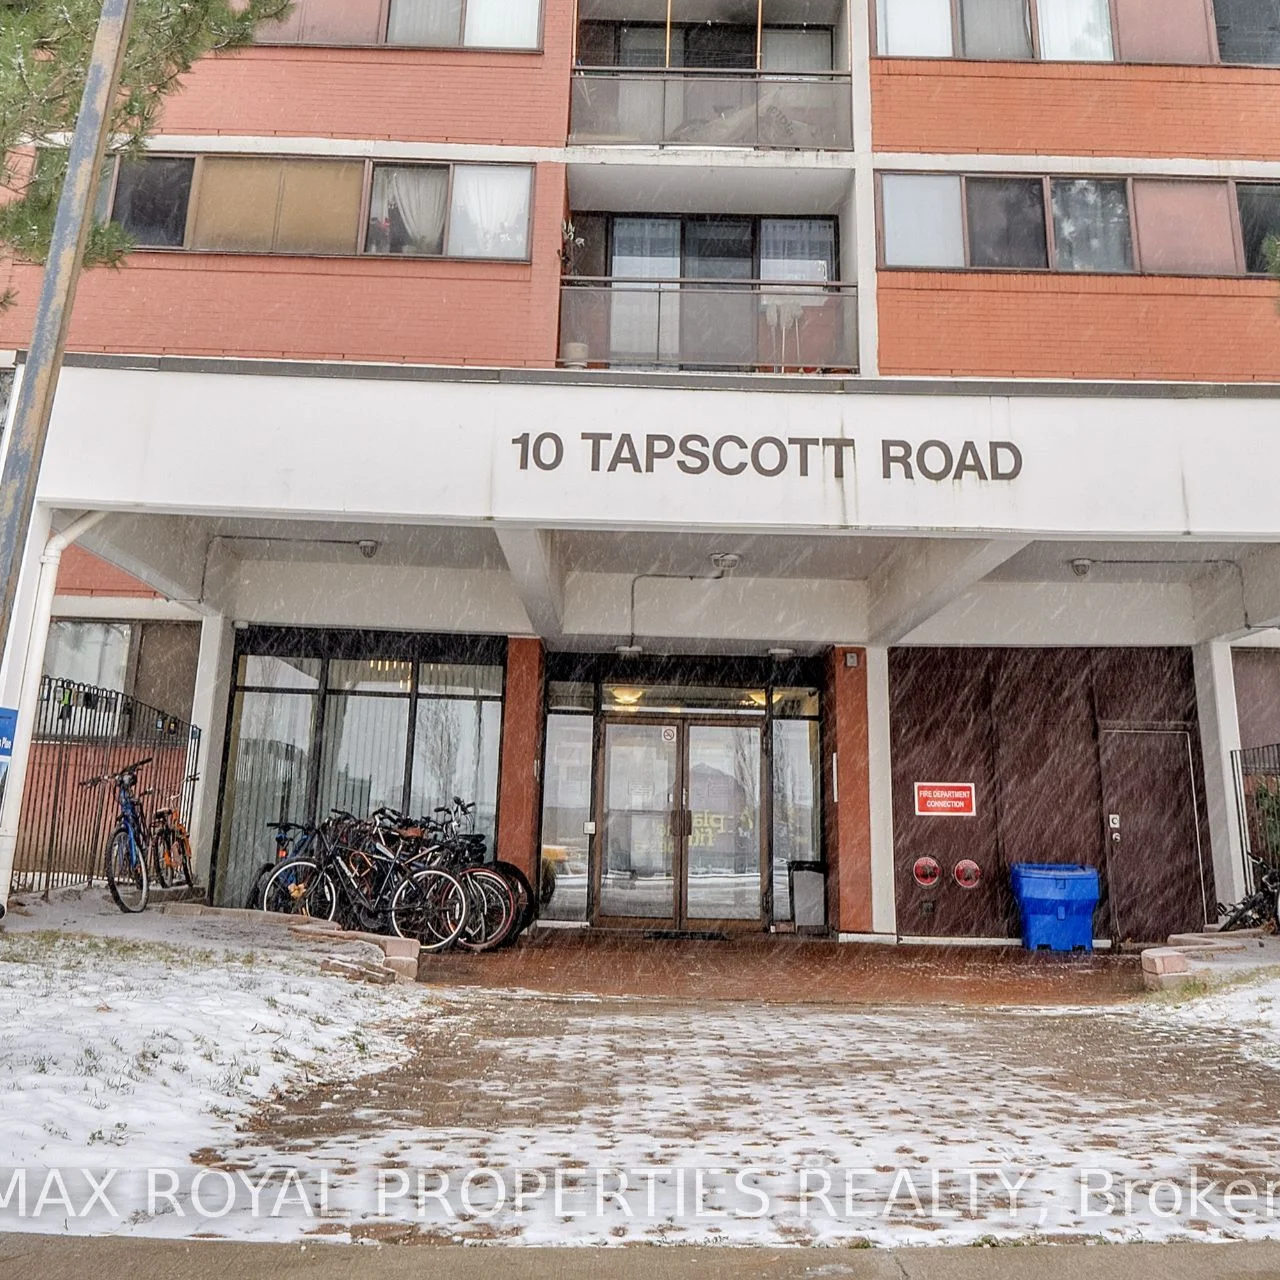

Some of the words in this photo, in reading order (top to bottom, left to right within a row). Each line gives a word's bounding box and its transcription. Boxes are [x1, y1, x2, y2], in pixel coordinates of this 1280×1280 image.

[511, 431, 564, 471] 10
[580, 432, 856, 478] TAPSCOTT
[881, 439, 1023, 482] ROAD
[919, 790, 933, 798] FIRE
[933, 790, 970, 798] DEPARTMENT
[926, 800, 965, 808] CONNECTION
